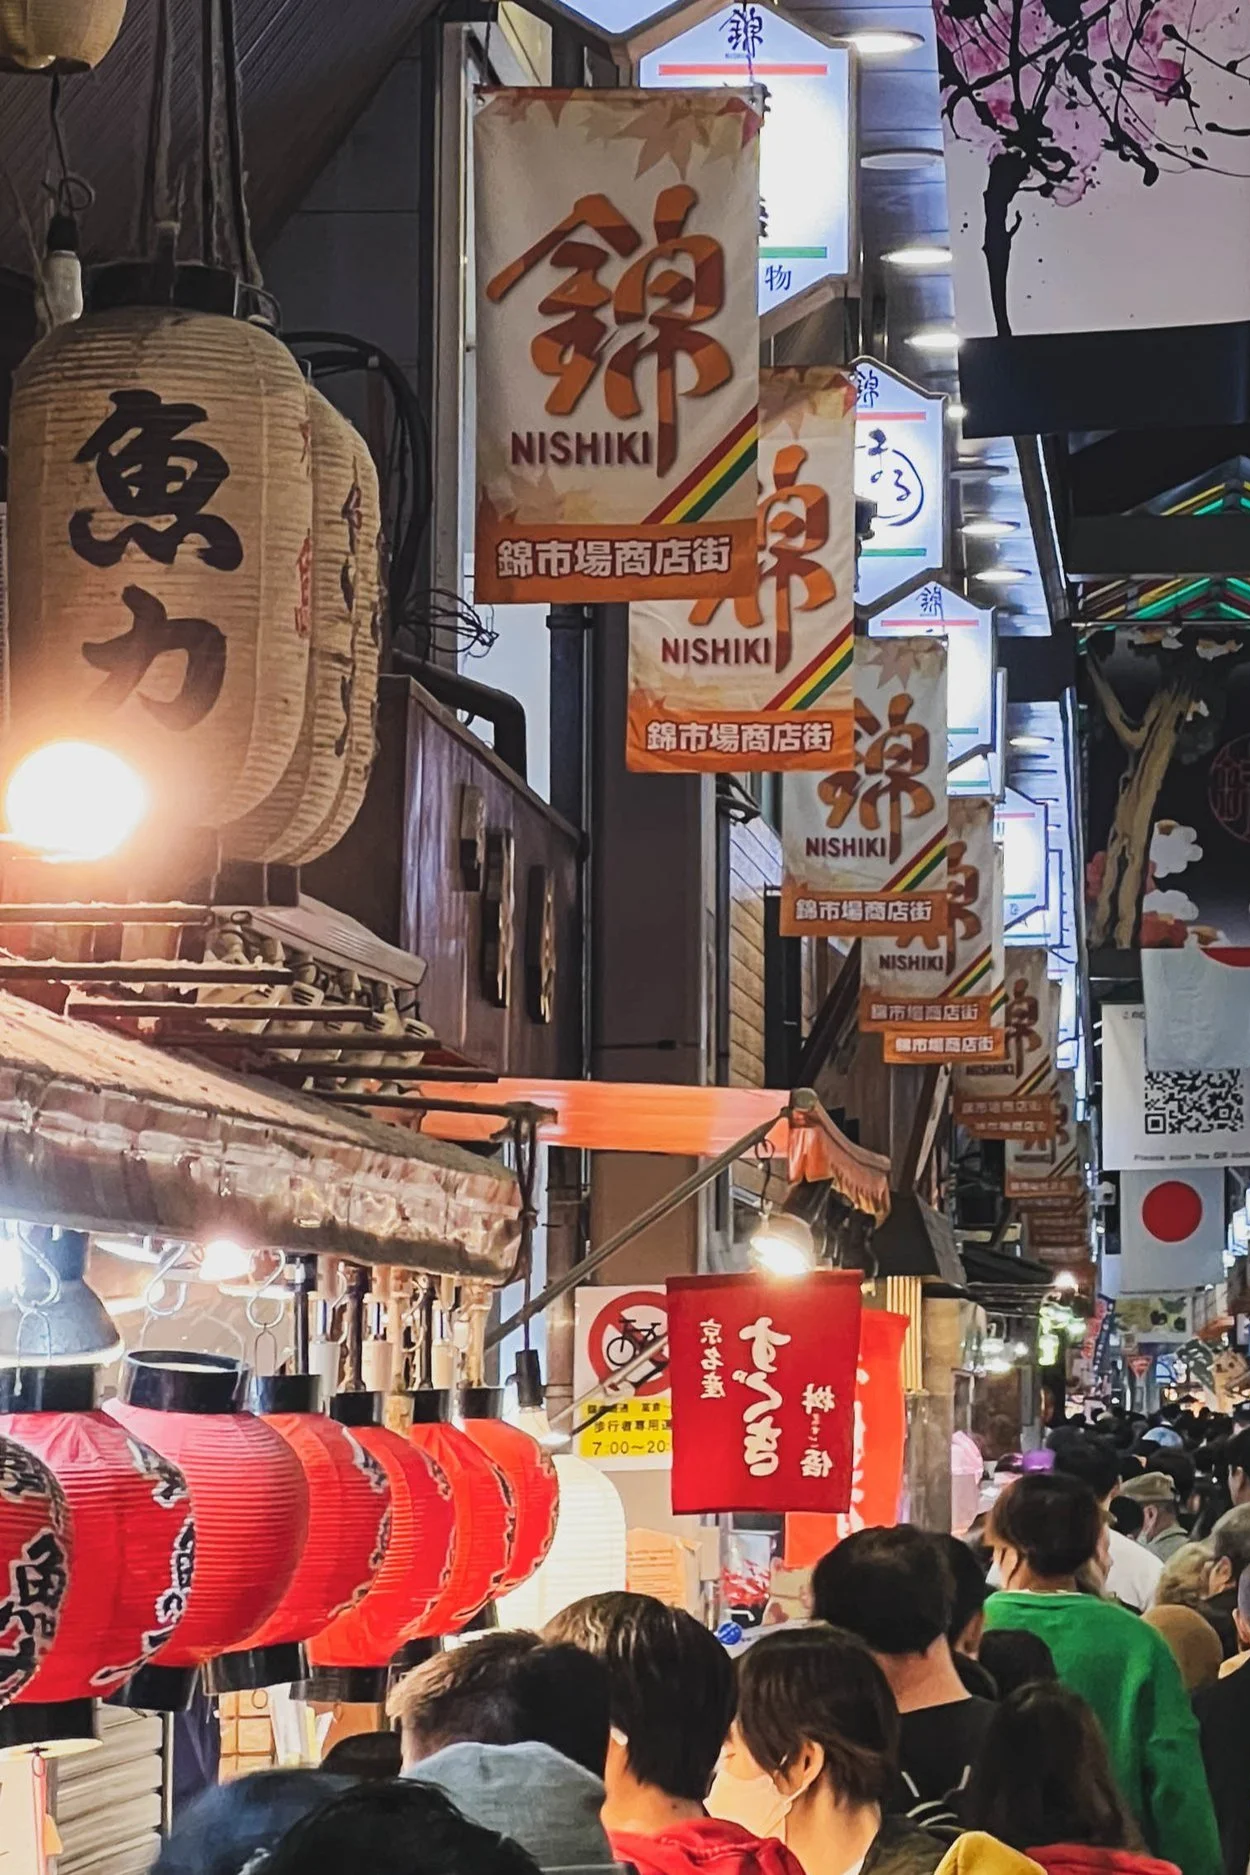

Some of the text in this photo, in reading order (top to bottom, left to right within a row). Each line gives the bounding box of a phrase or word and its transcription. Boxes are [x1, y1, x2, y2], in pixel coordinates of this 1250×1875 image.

[719, 7, 763, 58] 錦
[487, 184, 733, 477] 錦
[511, 431, 651, 466] NISHIKI
[68, 389, 244, 731] 魚力
[497, 536, 731, 578] 錦市場商店街
[662, 638, 771, 665] NISHIKI
[646, 721, 833, 754] 錦市場商店街
[806, 837, 887, 857] NISHIKI
[796, 898, 932, 922] 錦市場商店街
[879, 955, 943, 971] NISHIKI
